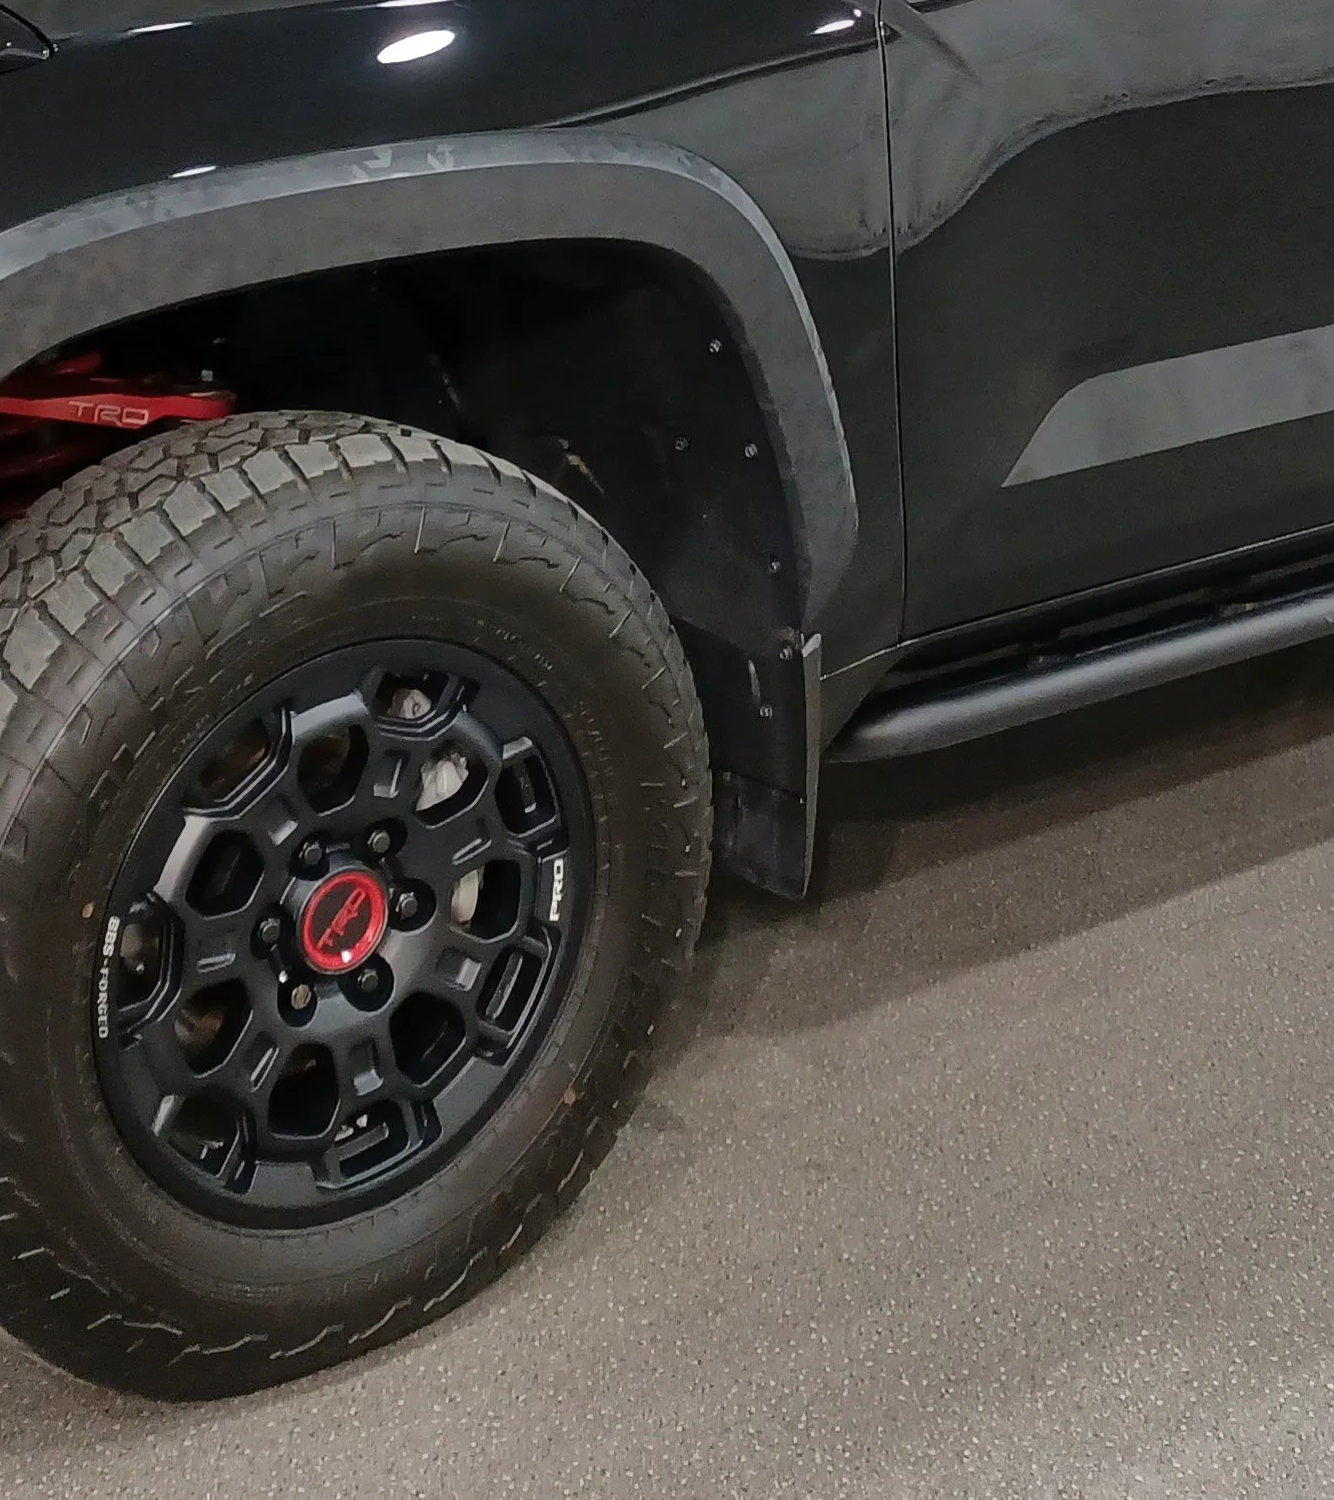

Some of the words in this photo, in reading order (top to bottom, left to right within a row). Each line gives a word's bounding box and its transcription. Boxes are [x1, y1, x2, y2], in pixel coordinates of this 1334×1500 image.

[69, 400, 150, 428] TRD
[313, 887, 367, 950] TRD
[549, 858, 564, 922] PRO
